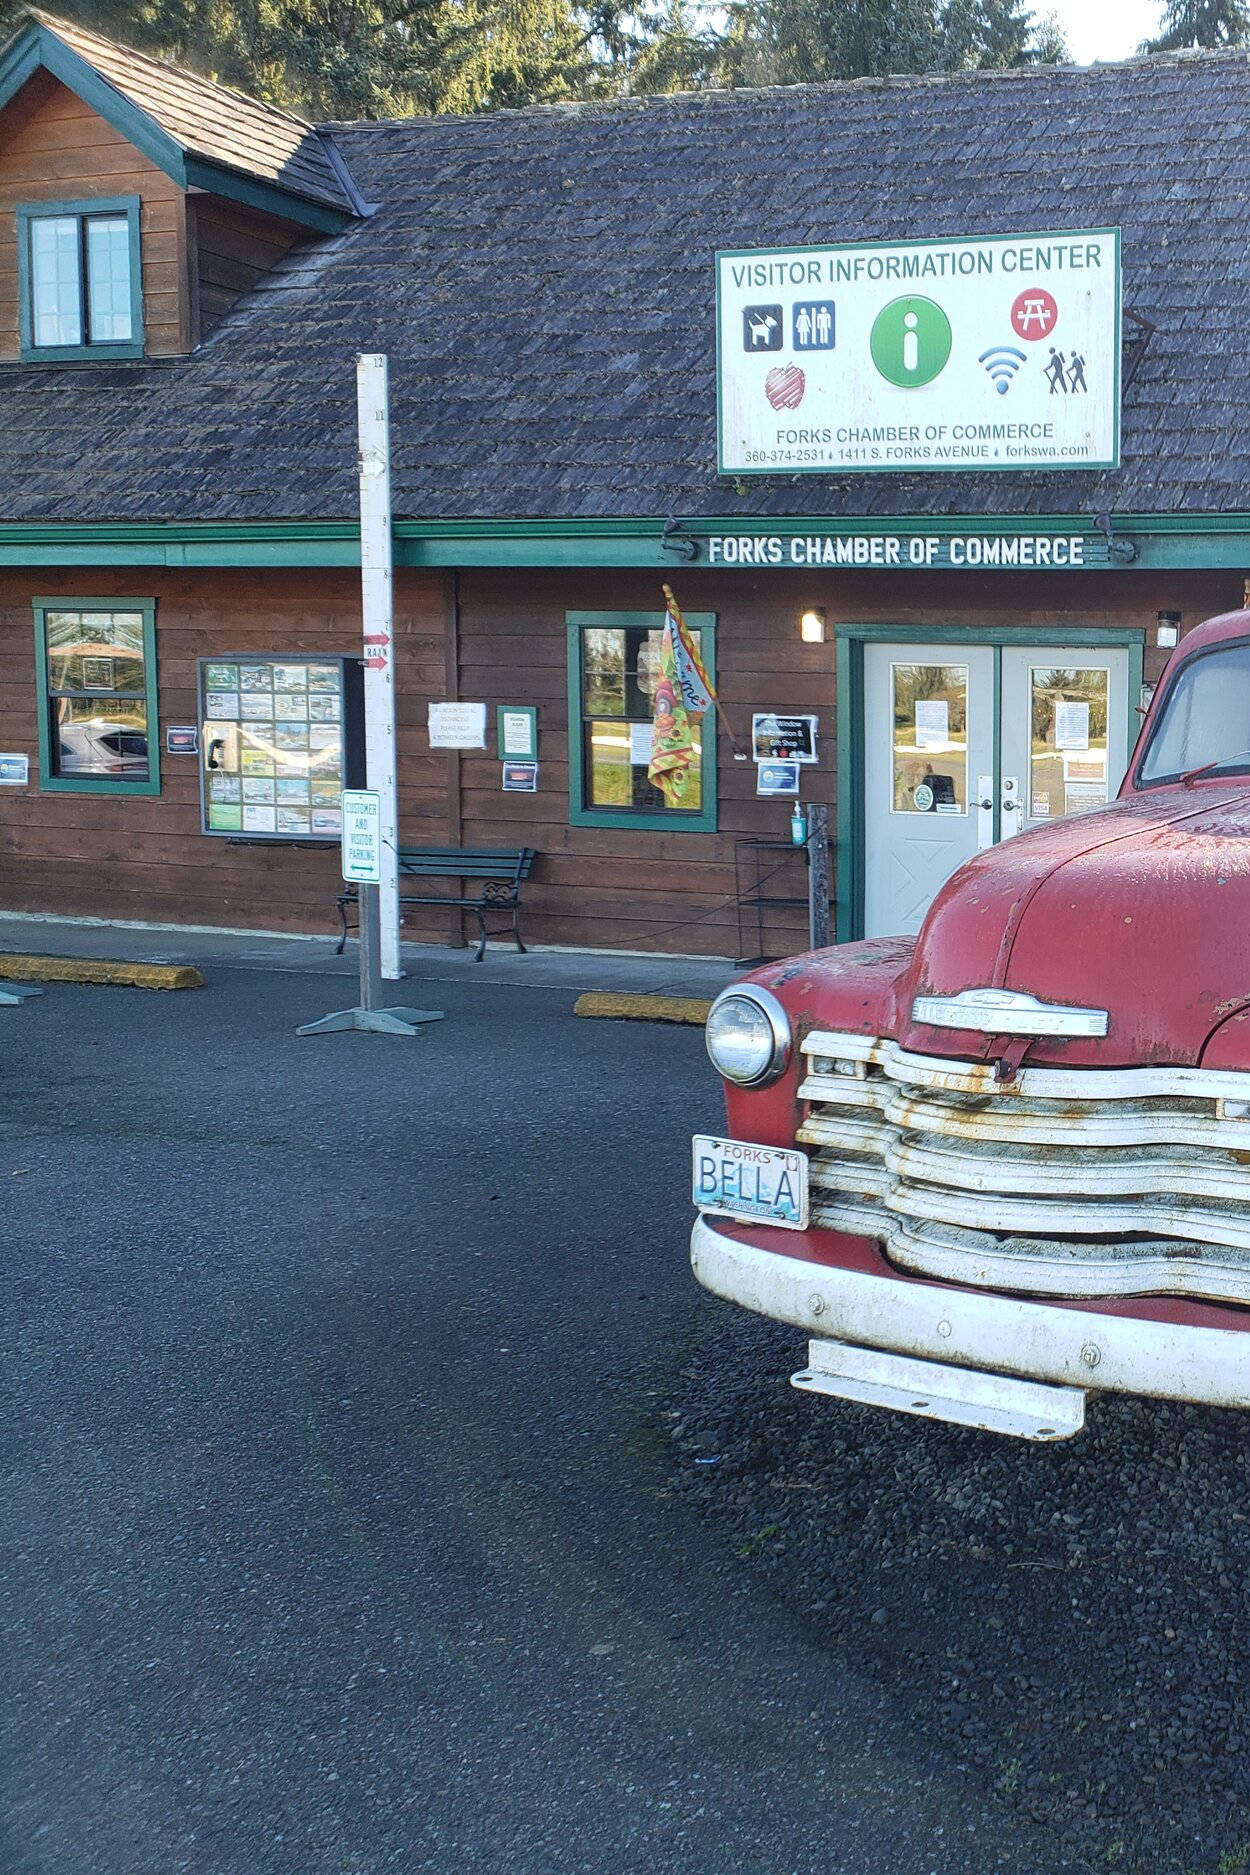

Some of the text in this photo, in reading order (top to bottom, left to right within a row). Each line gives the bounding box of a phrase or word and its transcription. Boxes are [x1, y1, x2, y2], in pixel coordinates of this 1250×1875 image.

[732, 244, 1101, 288] VISITOR INFORMATION CENTER
[776, 424, 1054, 445] FORKS CHAMBER OF COMMERCE
[745, 444, 1089, 463] 360-374-2531 1411 S. FORKS AVENUE forkswa.com
[708, 537, 1084, 565] FORKS CHAMBER OF COMMERCE
[367, 648, 388, 657] RAIN
[345, 802, 377, 815] CUSTOMER
[355, 818, 368, 830] AND
[351, 833, 373, 845] VISITOR
[349, 848, 375, 861] PARKING
[724, 1145, 771, 1164] FORKS
[700, 1156, 796, 1209] BELLA
